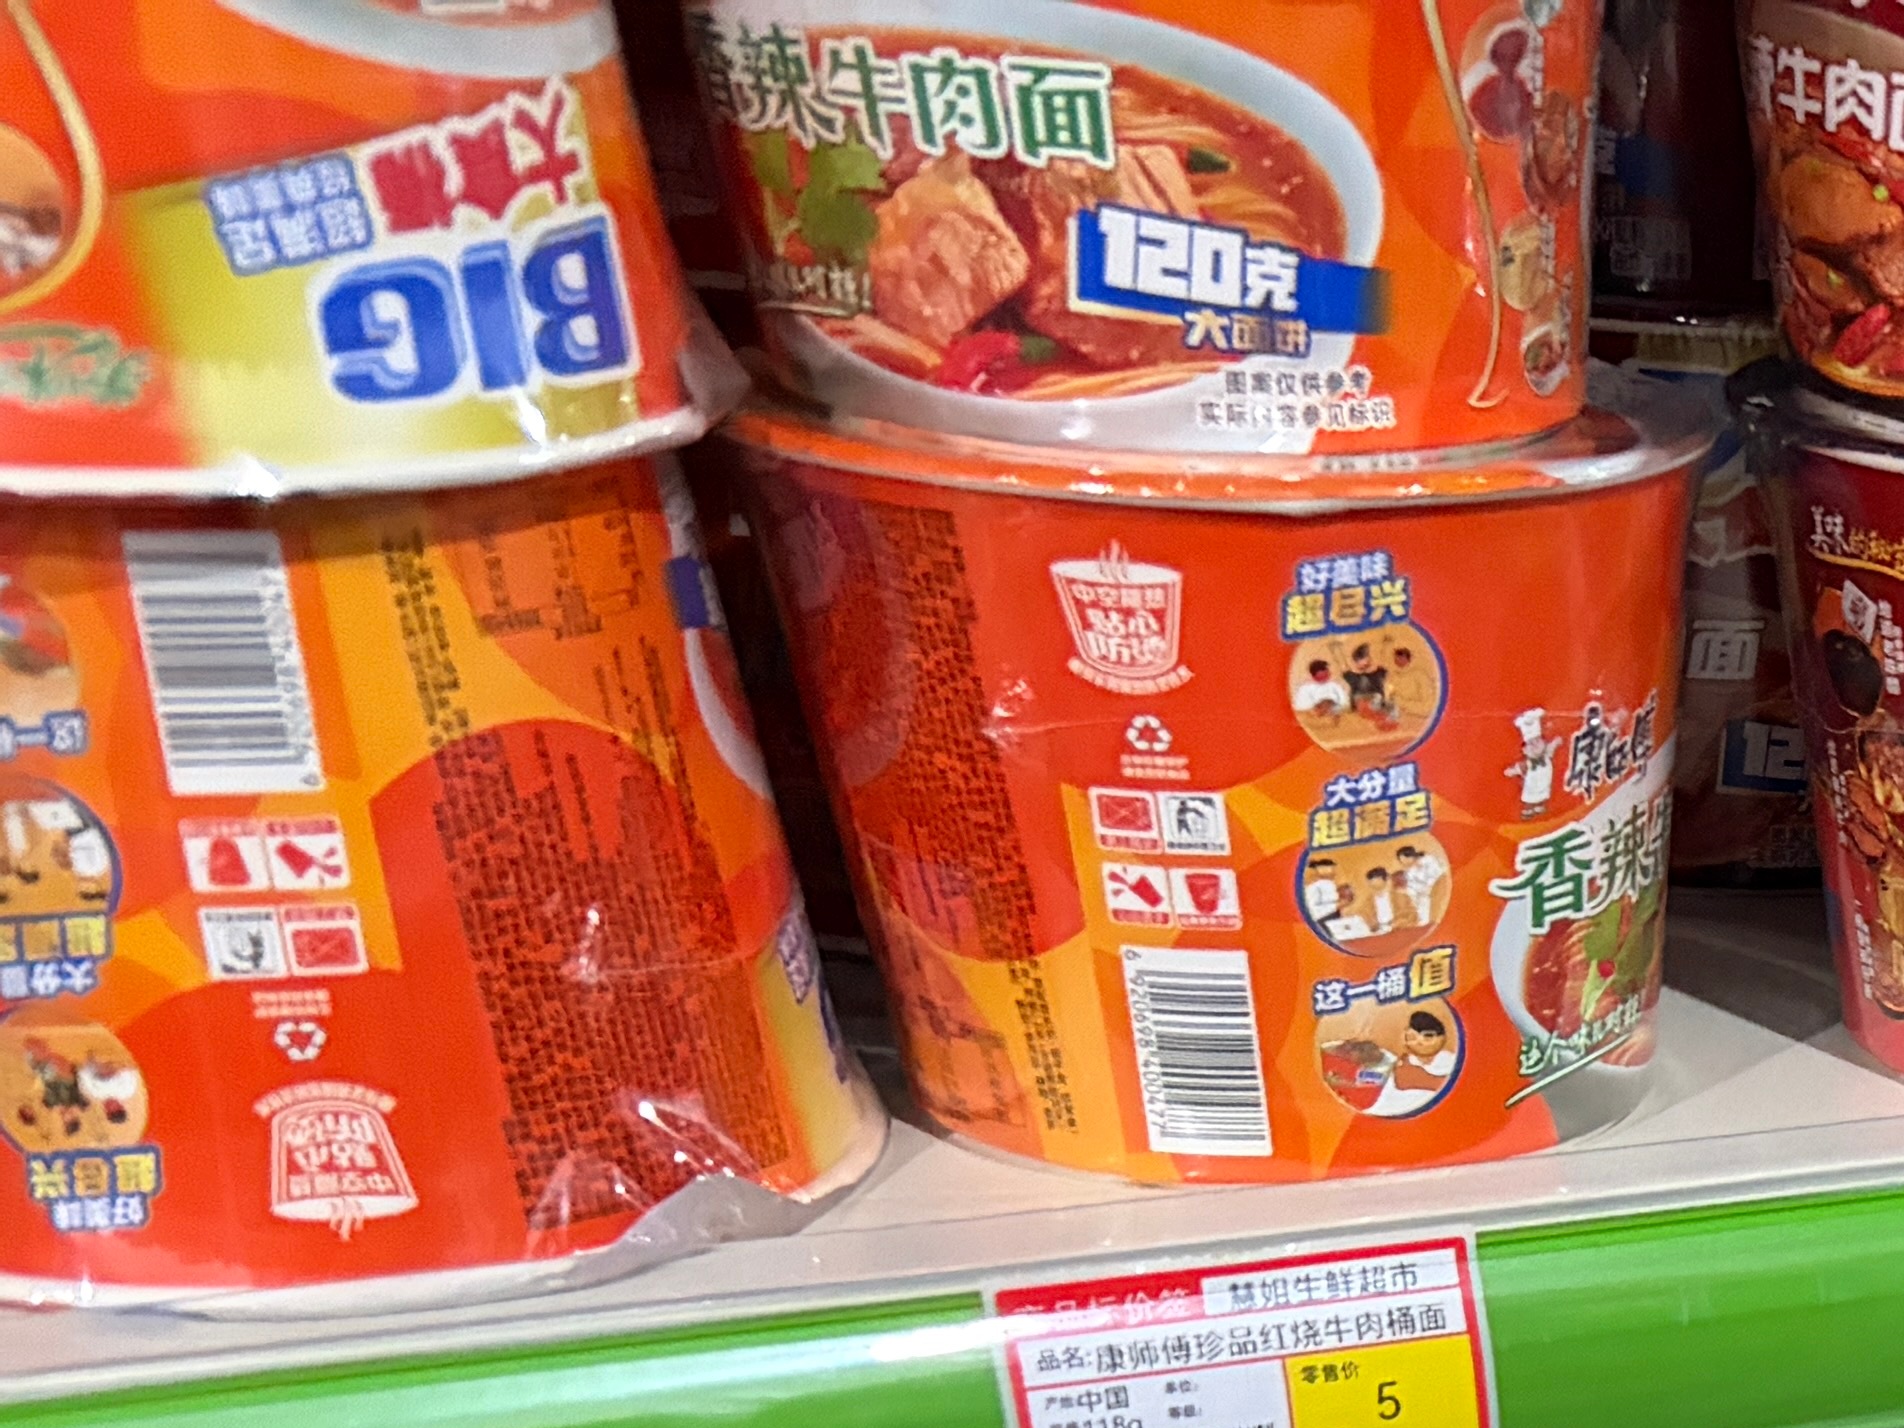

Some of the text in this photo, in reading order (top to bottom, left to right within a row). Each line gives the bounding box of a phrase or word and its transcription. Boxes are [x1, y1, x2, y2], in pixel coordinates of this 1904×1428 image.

[1097, 205, 1303, 317] 120克
[318, 216, 636, 404] BIG
[1327, 764, 1420, 805] 大分量
[1313, 946, 1457, 1014] 这一桶值
[1300, 1361, 1360, 1385] 零售价
[1076, 1385, 1130, 1412] 中国
[1377, 1379, 1402, 1421] 5
